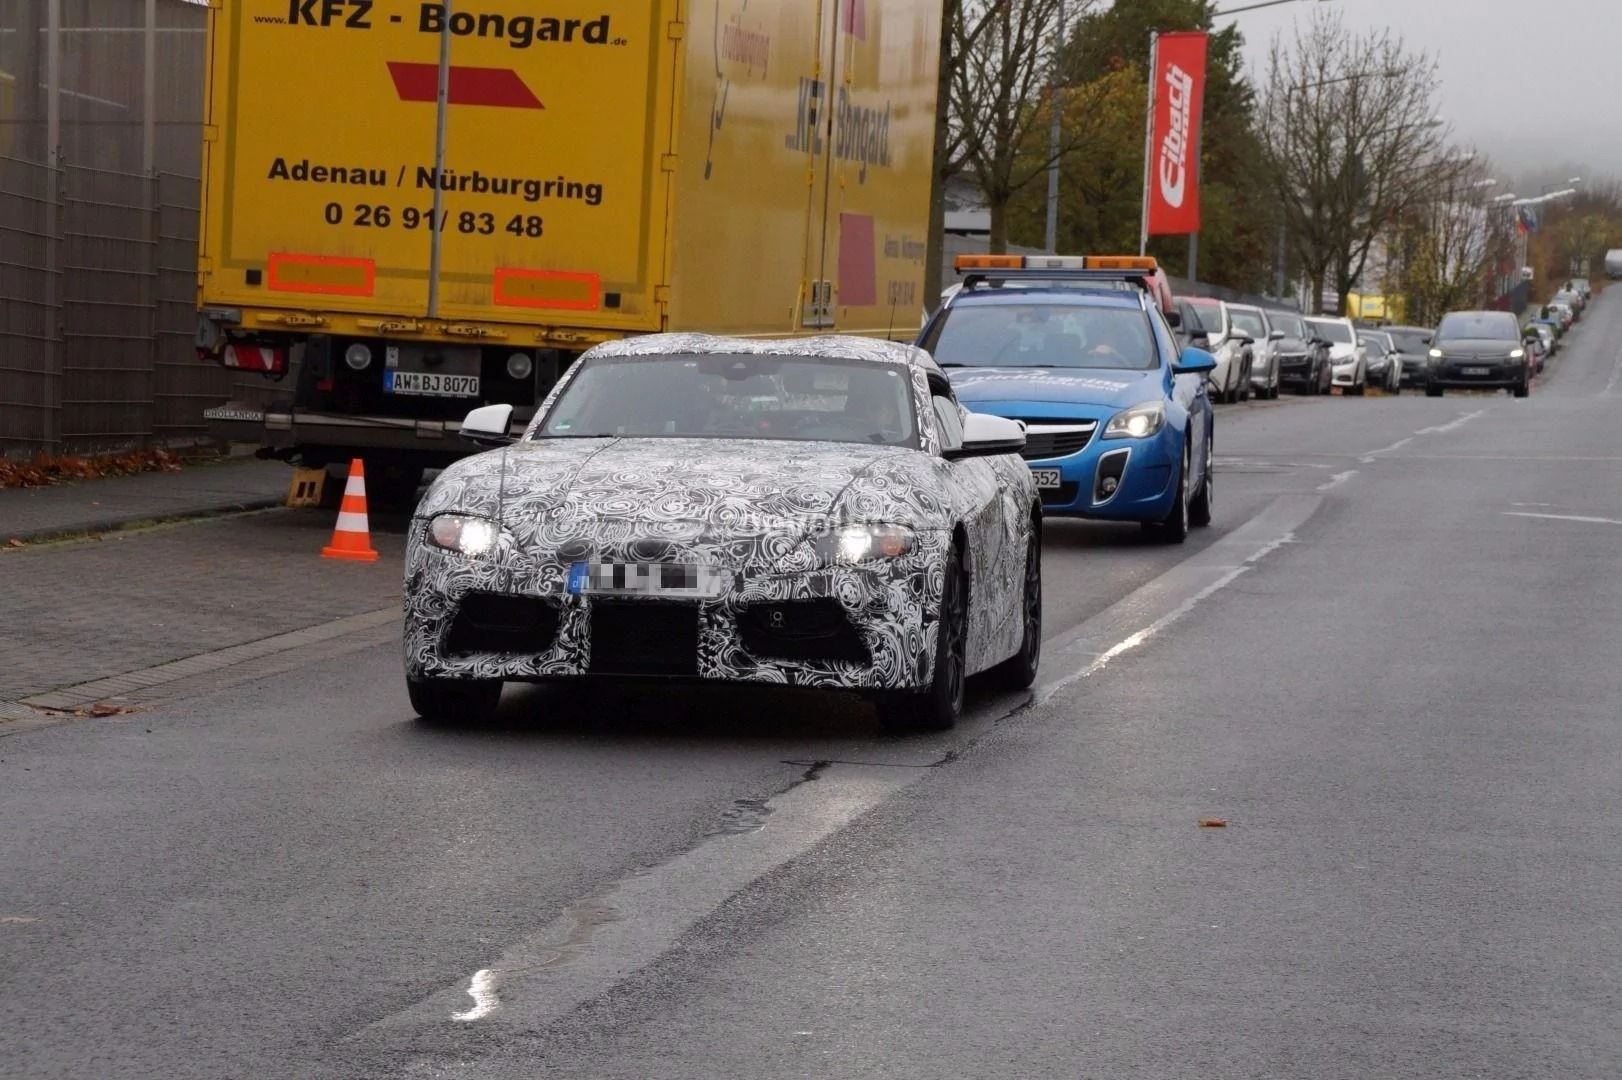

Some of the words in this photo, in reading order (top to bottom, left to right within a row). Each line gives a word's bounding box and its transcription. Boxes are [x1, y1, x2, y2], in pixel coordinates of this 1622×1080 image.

[267, 157, 386, 186] Adenau
[416, 166, 603, 206] Nürburgring
[324, 202, 343, 225] 0
[353, 204, 391, 228] 26
[458, 211, 495, 235] 83
[505, 214, 543, 237] 48
[394, 374, 412, 390] AW
[422, 375, 440, 391] BJ
[443, 376, 478, 393] 8070
